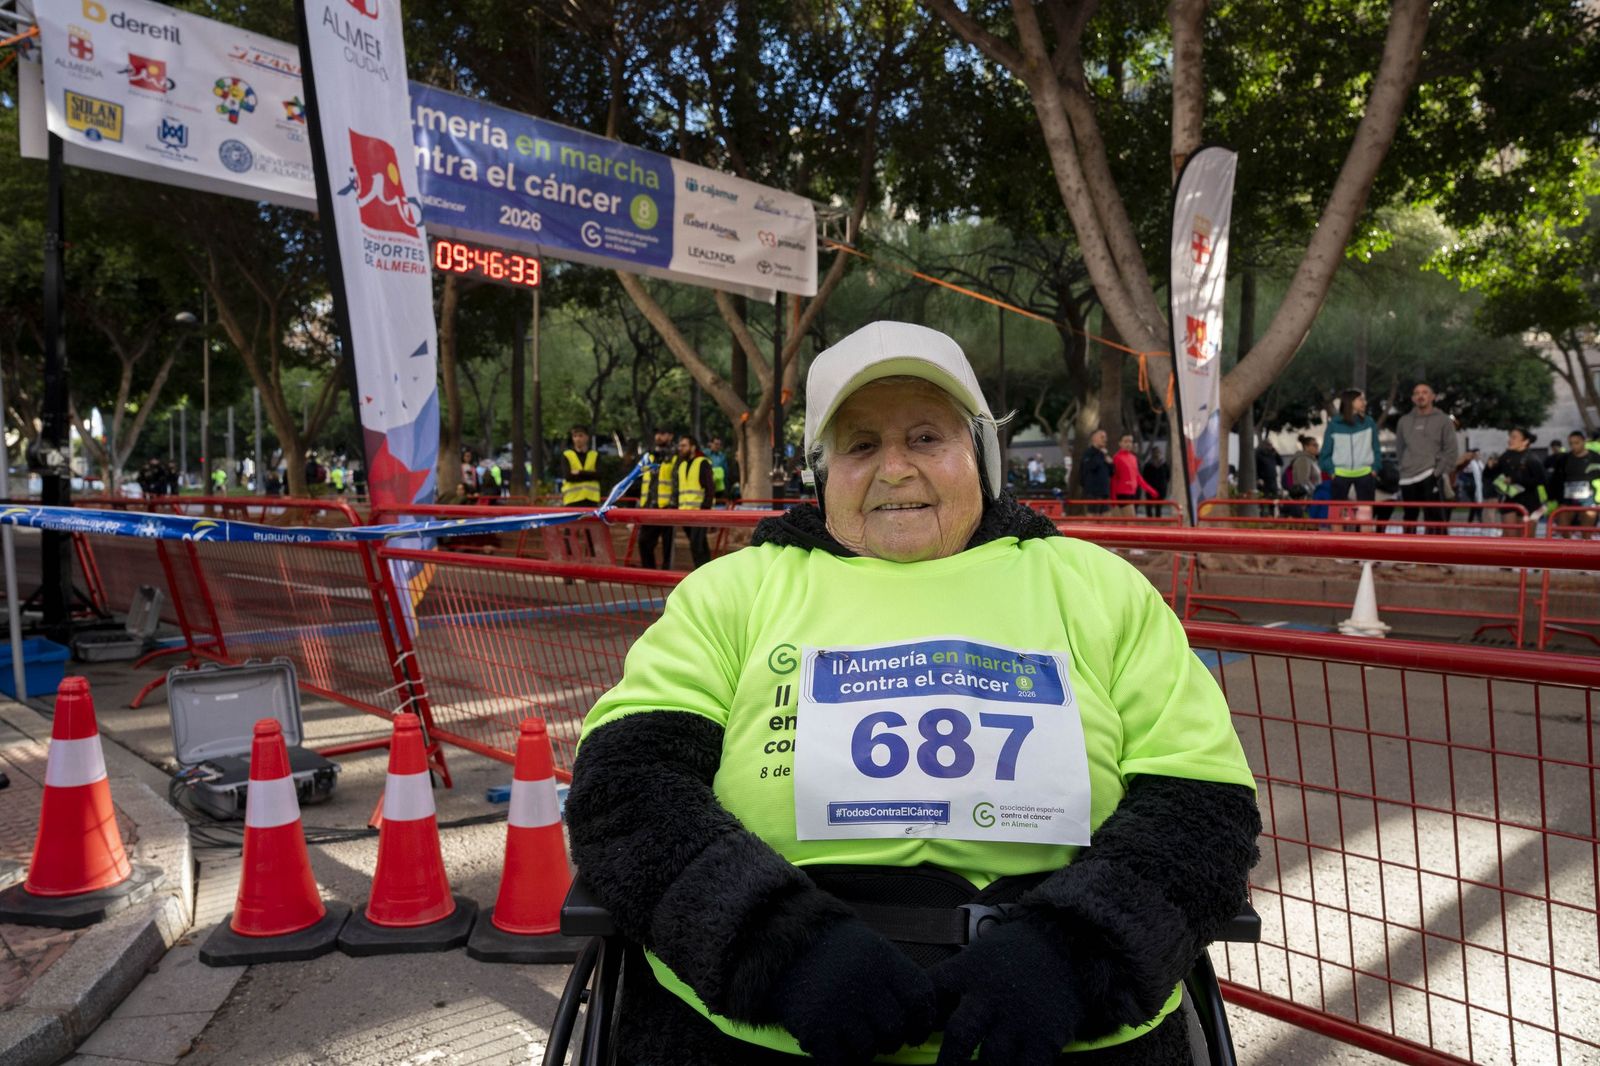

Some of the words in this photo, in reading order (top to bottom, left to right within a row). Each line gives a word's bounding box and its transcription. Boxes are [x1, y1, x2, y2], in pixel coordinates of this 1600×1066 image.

[110, 11, 181, 45] deretil
[515, 134, 551, 161] en
[560, 145, 660, 190] marcha
[414, 145, 478, 182] ntra
[487, 162, 516, 191] el
[524, 173, 622, 215] cáncer
[639, 200, 650, 219] 8
[701, 184, 738, 203] cajamar
[499, 205, 542, 232] 2026
[364, 236, 426, 262] DEPORTES
[688, 246, 736, 265] LEALTADIS
[435, 240, 540, 286] 09:46:33
[847, 651, 927, 674] Almería
[932, 651, 959, 664] en
[965, 654, 1037, 675] marcha
[840, 676, 908, 694] contra
[915, 670, 935, 687] el
[941, 670, 1010, 693] cáncer
[1020, 678, 1028, 687] 8
[1018, 690, 1037, 698] 2026
[769, 715, 798, 731] en
[851, 708, 1034, 781] 687
[760, 767, 768, 779] 8
[773, 765, 791, 777] de
[835, 807, 944, 818] #TodosContraElCáncer
[1030, 813, 1052, 821] cáncer
[1036, 806, 1065, 814] española
[1011, 820, 1039, 828] Almería
